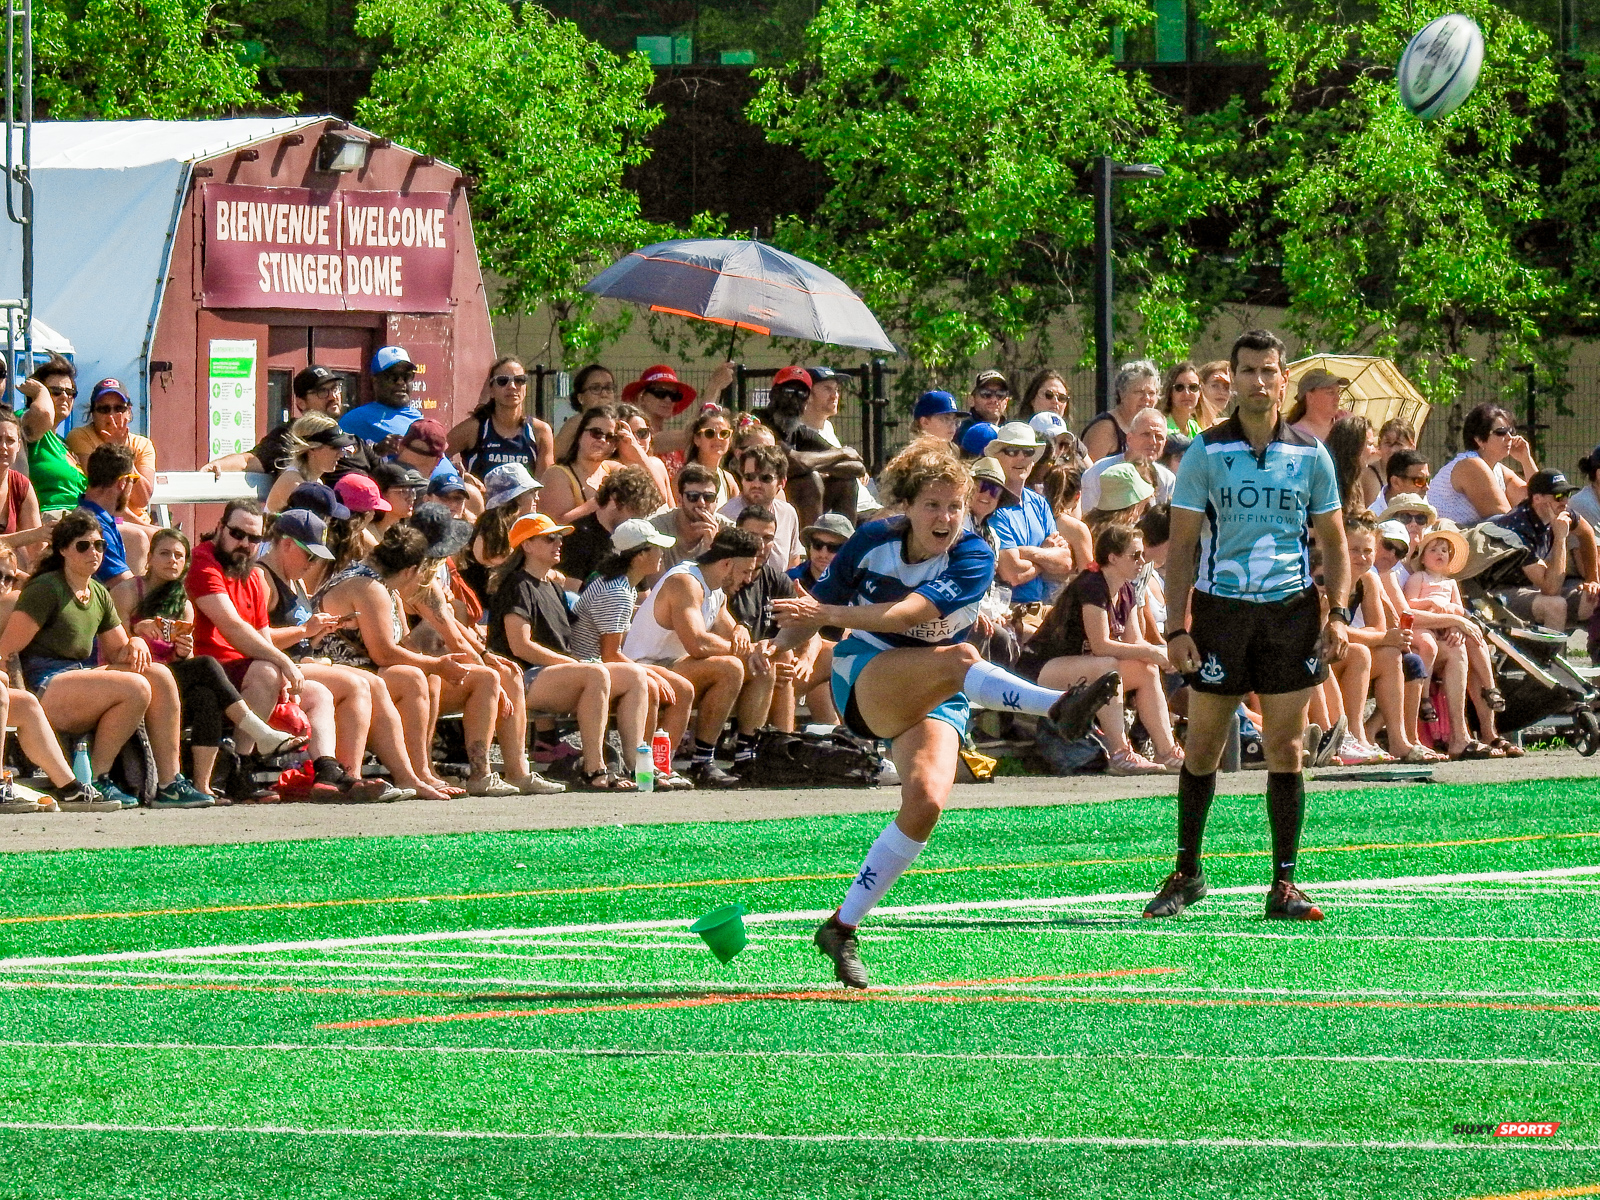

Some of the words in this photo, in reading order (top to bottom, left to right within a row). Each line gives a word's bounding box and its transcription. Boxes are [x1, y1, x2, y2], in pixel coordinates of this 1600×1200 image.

[216, 200, 330, 245] BIENVENUE
[347, 205, 447, 248] WELCOME
[258, 252, 343, 295] STINGER
[346, 255, 403, 297] DOME
